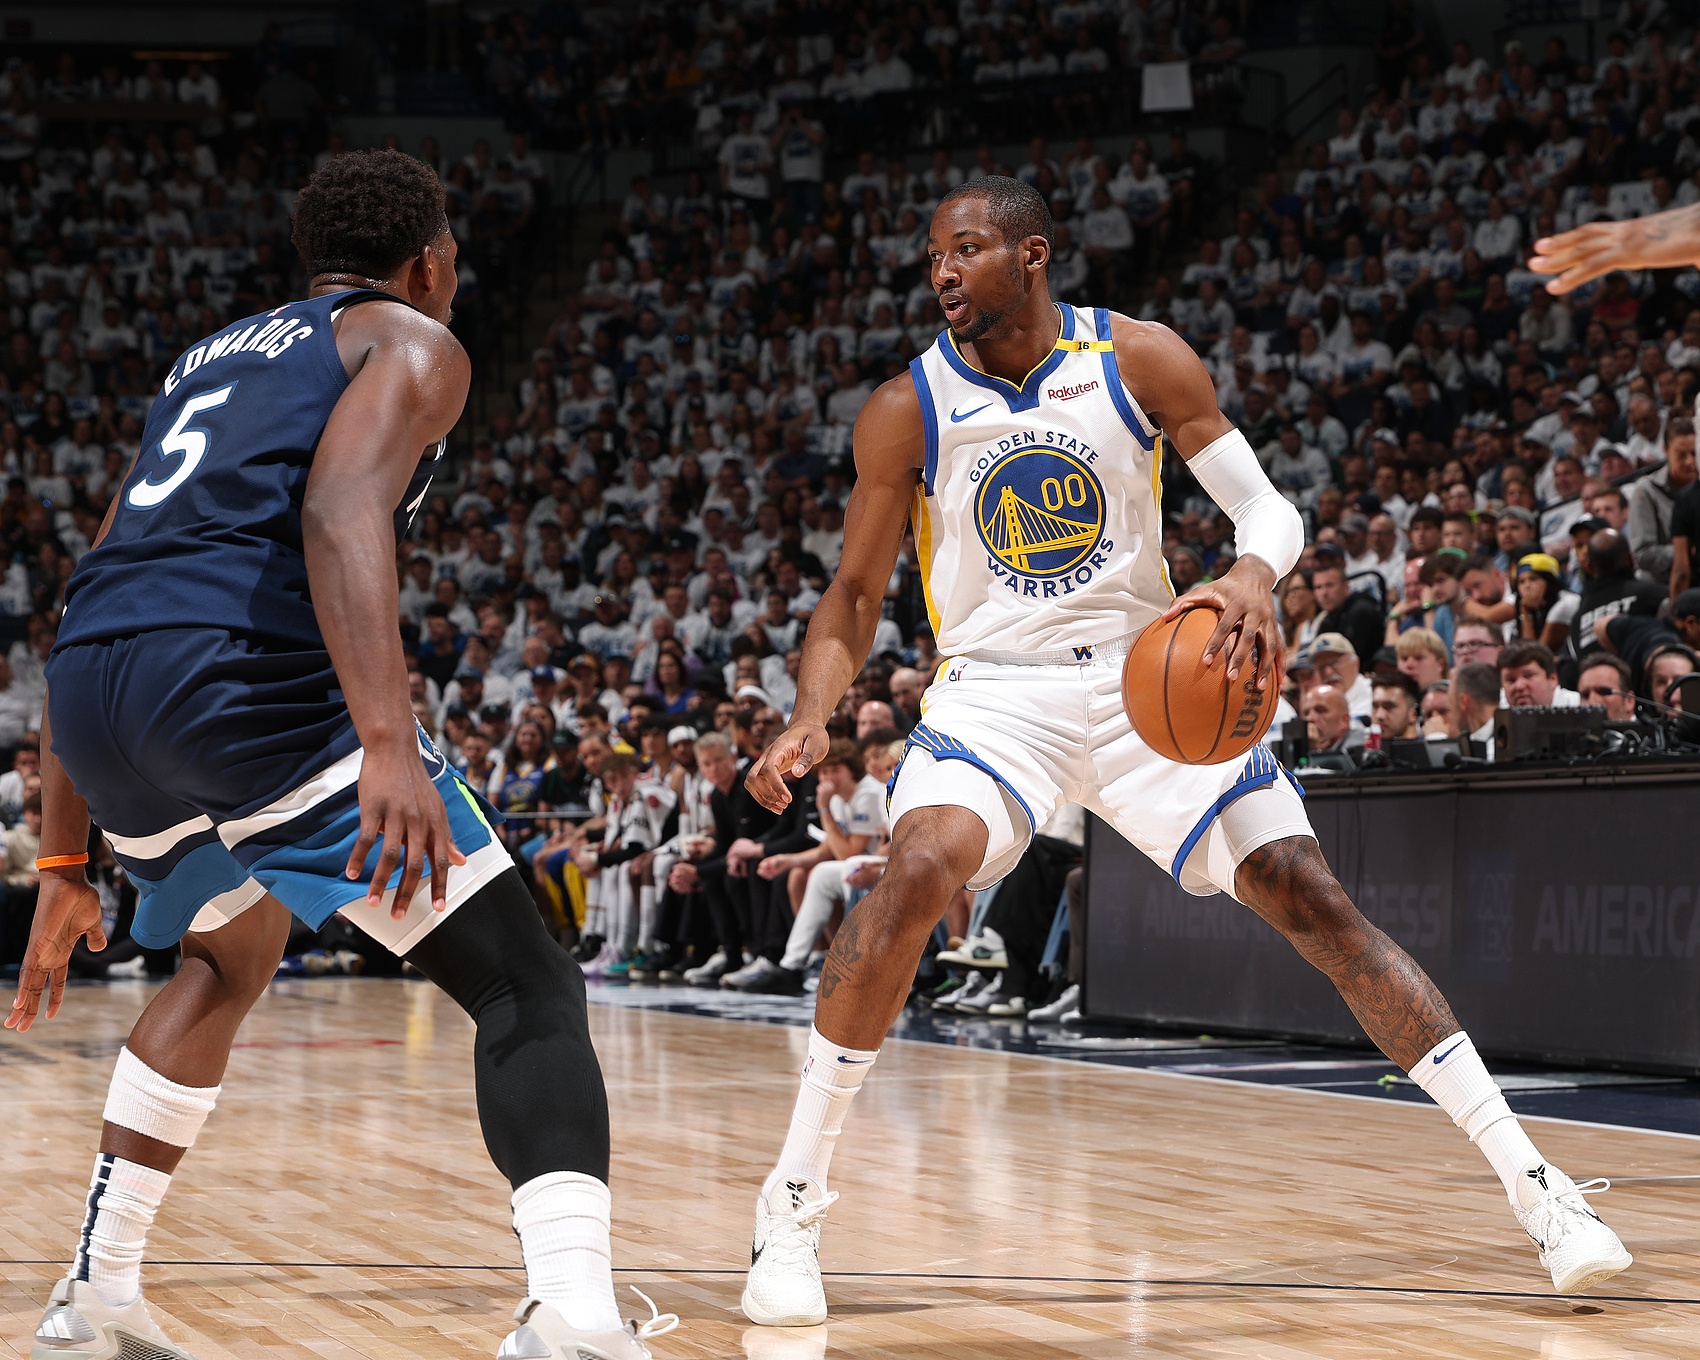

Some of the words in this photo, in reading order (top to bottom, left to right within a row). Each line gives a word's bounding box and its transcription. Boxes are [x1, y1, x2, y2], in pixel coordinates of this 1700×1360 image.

[164, 318, 314, 398] EDWARDS
[1077, 341, 1090, 351] 16
[1047, 380, 1099, 401] Rakuten
[125, 381, 239, 511] 5
[969, 430, 1037, 484] GOLDEN
[1045, 430, 1100, 465] STATE
[1040, 473, 1088, 512] 00
[986, 537, 1115, 599] WARRIORS
